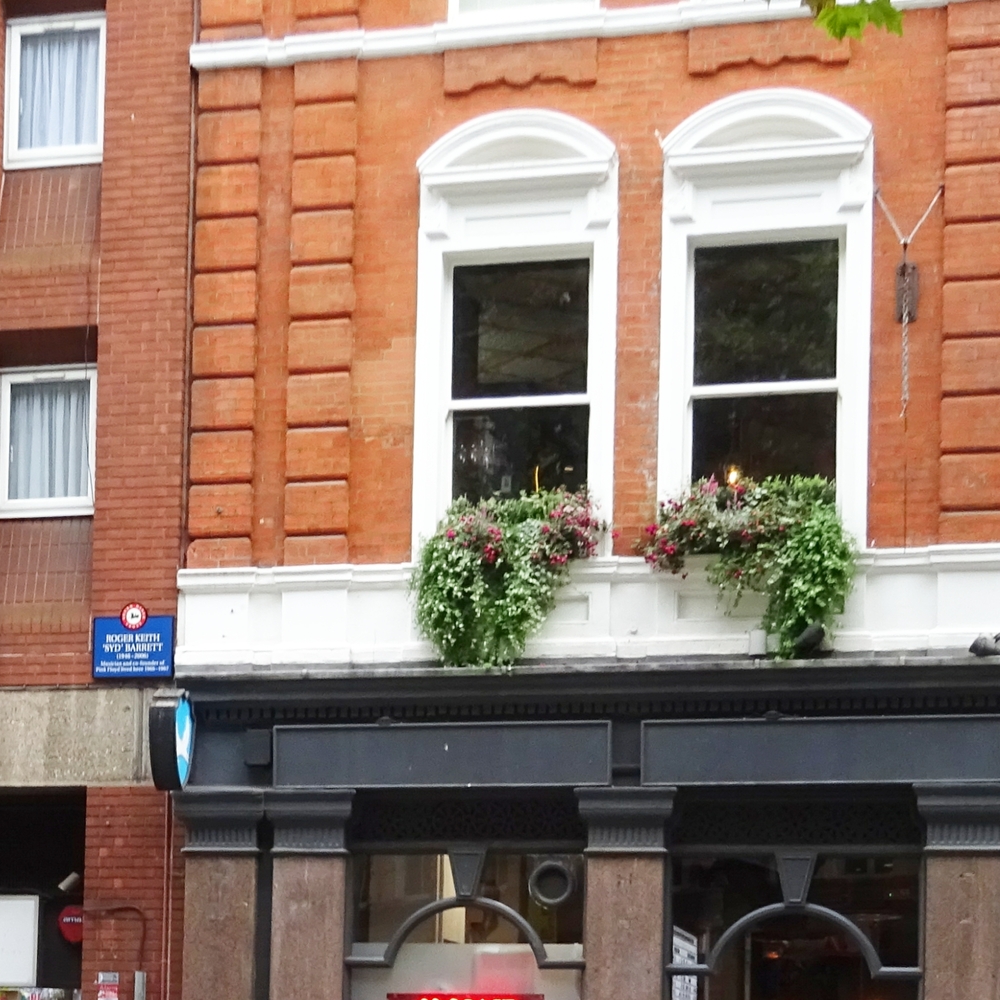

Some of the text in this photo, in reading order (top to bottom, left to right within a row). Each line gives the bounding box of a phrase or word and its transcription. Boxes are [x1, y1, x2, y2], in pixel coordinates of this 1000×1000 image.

[106, 633, 160, 643] ROGER KEITH
[125, 643, 164, 652] BARRETT
